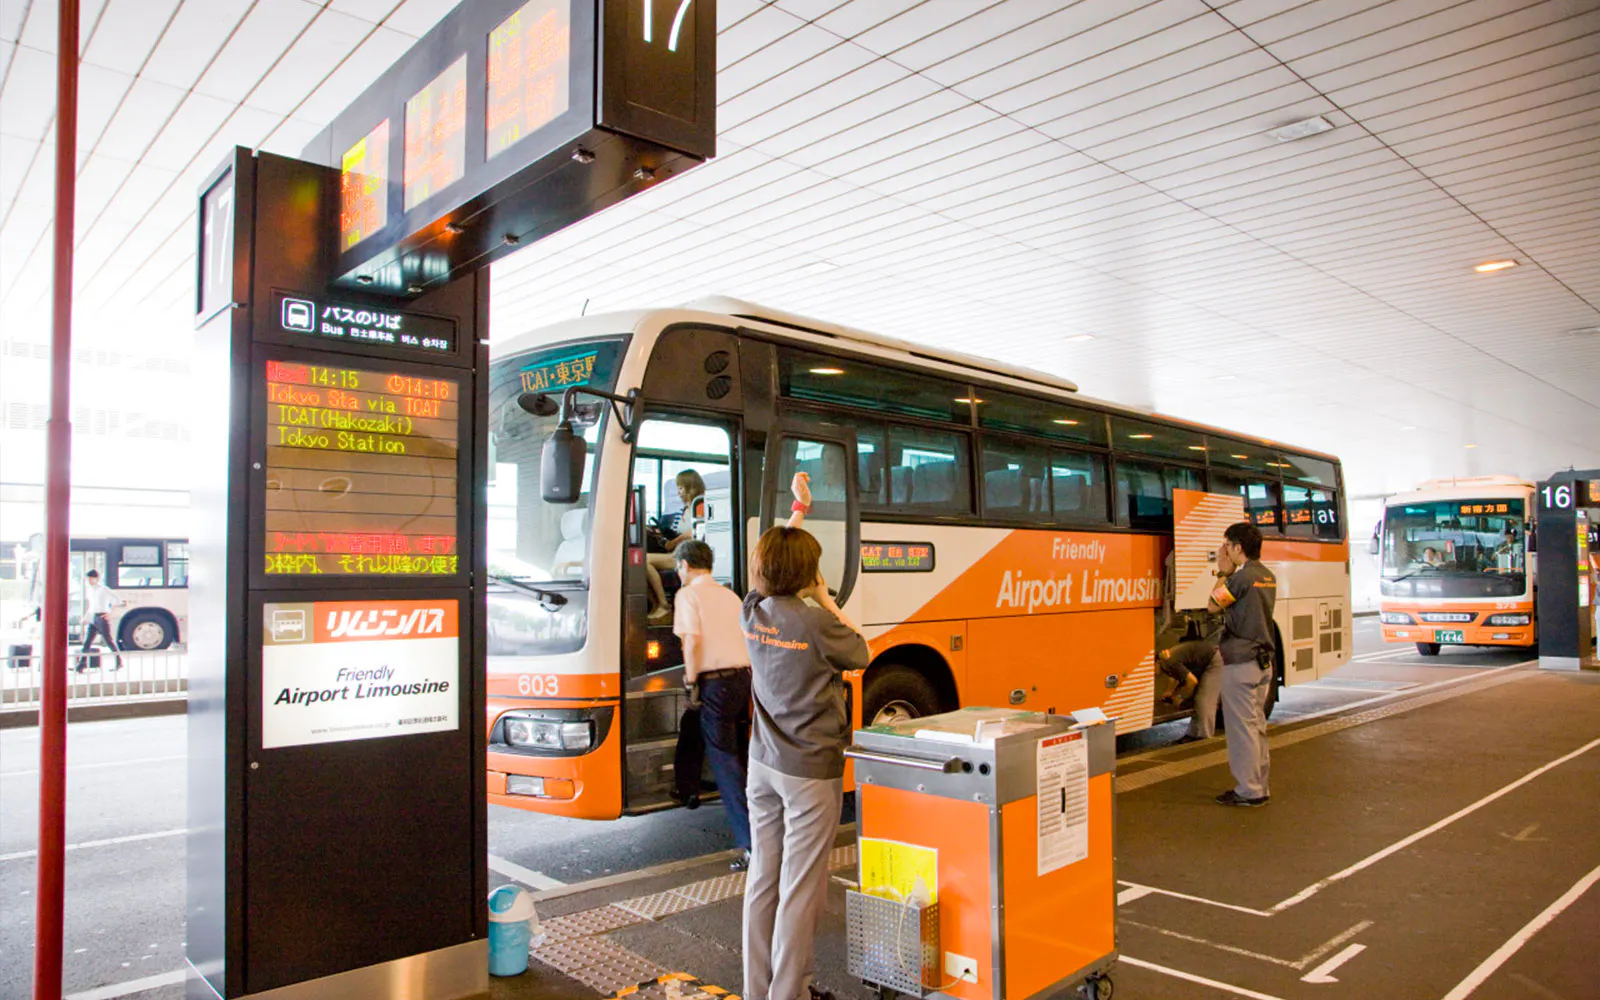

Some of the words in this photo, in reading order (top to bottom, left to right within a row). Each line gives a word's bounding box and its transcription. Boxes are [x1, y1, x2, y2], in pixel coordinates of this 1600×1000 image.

[321, 322, 344, 336] Bus
[322, 307, 403, 330] バスのりば
[401, 335, 419, 345] 버스
[311, 367, 359, 389] 14:15
[406, 376, 450, 400] 14:16
[268, 383, 320, 404] Tokyo
[328, 389, 359, 410] Sta
[367, 396, 396, 414] via
[405, 398, 441, 417] TCAT
[278, 405, 412, 435] TCAT(Hakozaki)
[277, 426, 329, 447] Tokyo
[337, 432, 406, 454] Station
[1541, 485, 1571, 508] 16
[1052, 537, 1106, 564] Friendly
[996, 570, 1073, 614] Airport
[326, 608, 445, 638] リムジンバス
[760, 634, 809, 650] Limousine
[336, 665, 395, 682] Friendly
[518, 675, 559, 696] 603
[274, 687, 349, 706] Airport
[354, 679, 450, 699] Limousine
